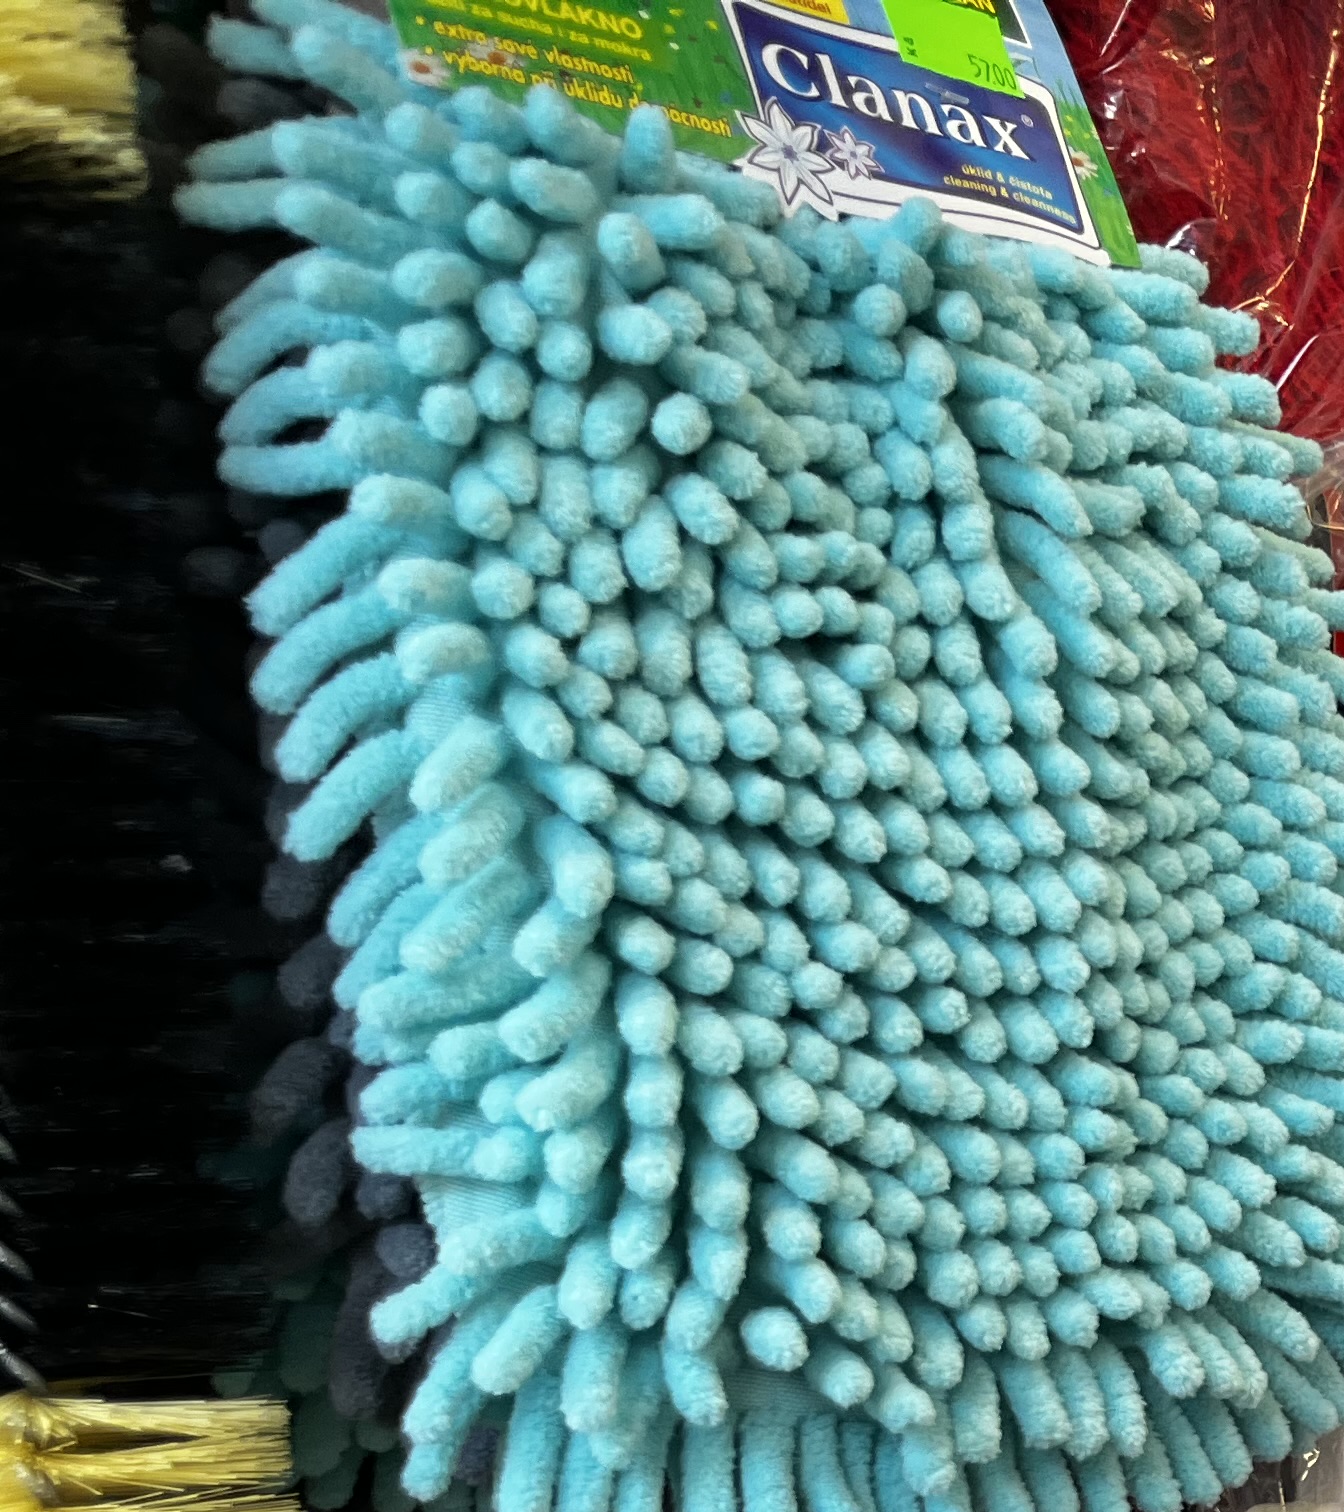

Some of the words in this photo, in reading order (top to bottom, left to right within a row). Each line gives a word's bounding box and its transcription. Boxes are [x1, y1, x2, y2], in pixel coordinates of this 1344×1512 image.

[433, 21, 488, 48] extra
[760, 43, 1036, 162] Clanax
[961, 163, 998, 182] úklid
[943, 174, 998, 196] cleaning
